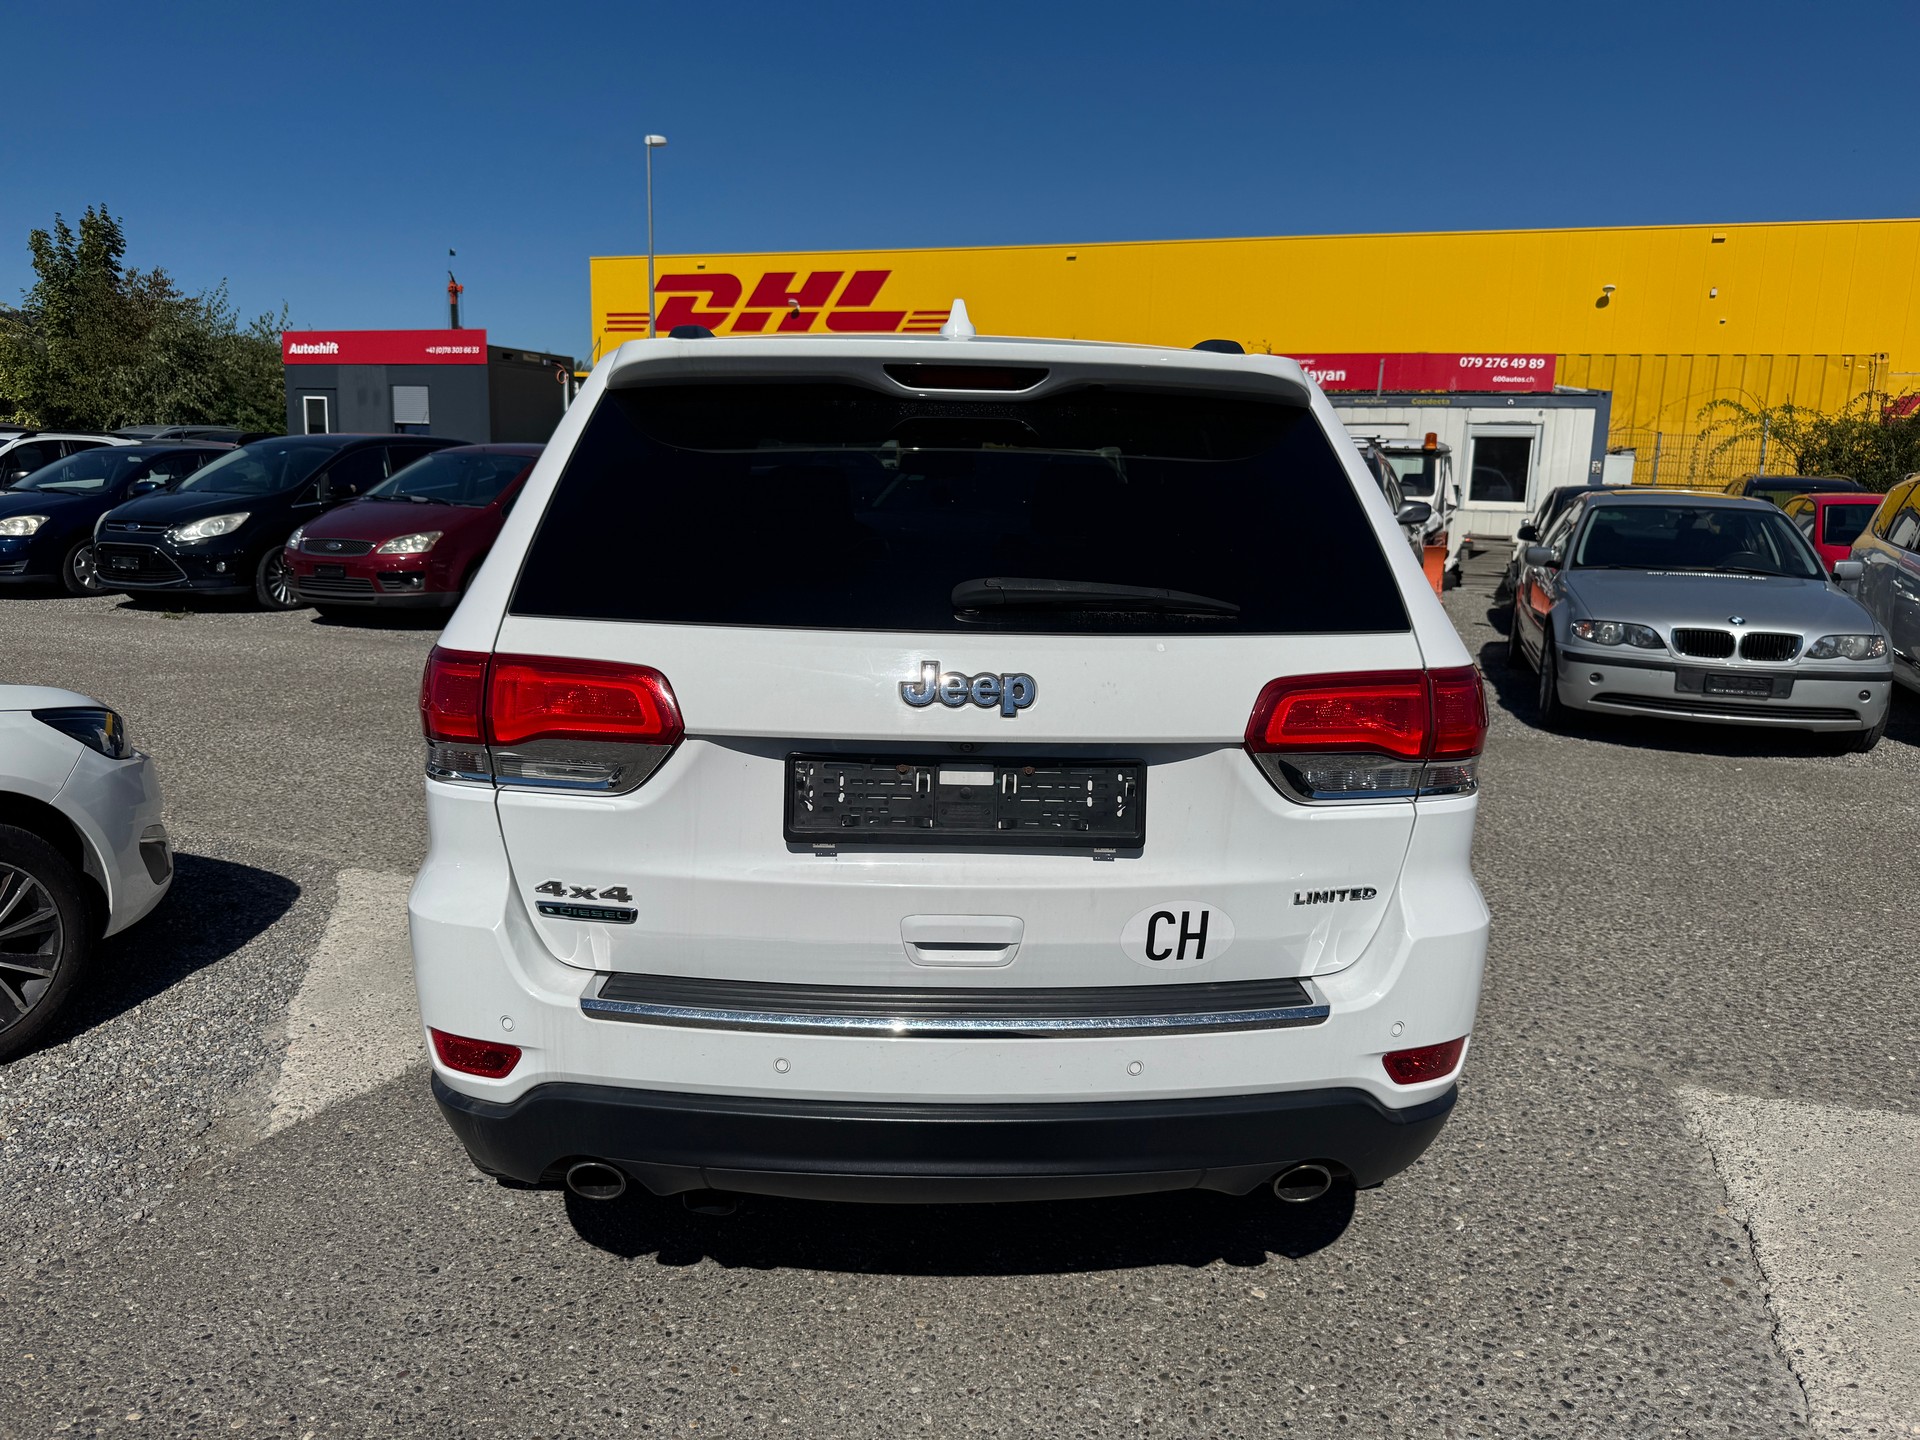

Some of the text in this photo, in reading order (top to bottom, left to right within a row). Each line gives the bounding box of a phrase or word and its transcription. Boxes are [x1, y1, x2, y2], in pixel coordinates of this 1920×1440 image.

[653, 270, 907, 332] DHL
[288, 342, 339, 355] Autoshift
[1459, 357, 1545, 369] 079 276 49 89
[1492, 375, 1535, 383] 600autos.ch
[900, 661, 1036, 718] Jeep
[534, 879, 633, 903] 4x4
[1293, 887, 1377, 906] LIMITED
[560, 905, 628, 920] DIESEL
[1145, 910, 1210, 961] CH
